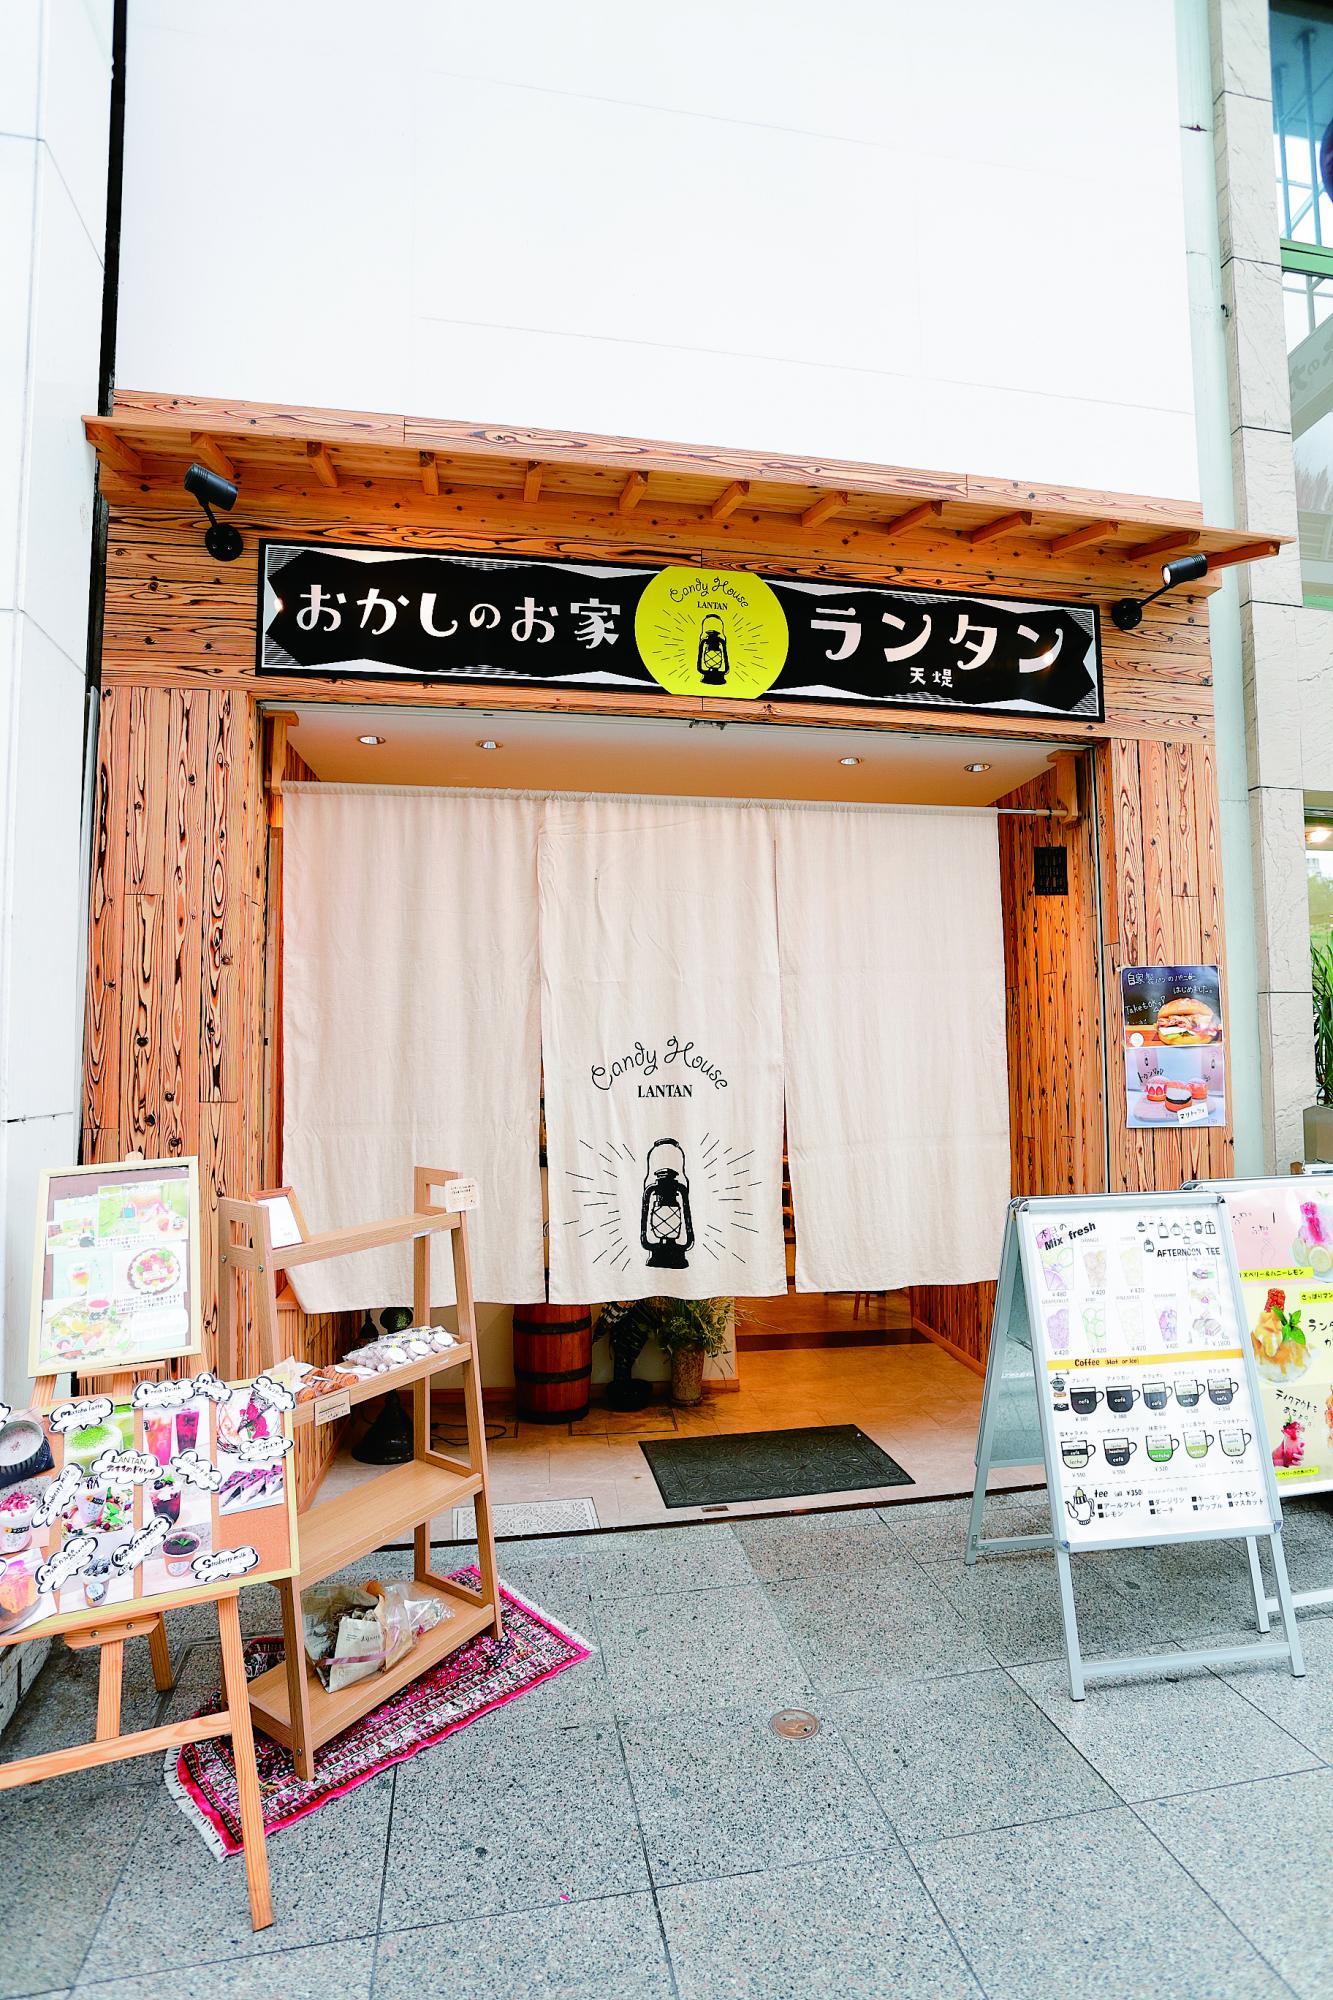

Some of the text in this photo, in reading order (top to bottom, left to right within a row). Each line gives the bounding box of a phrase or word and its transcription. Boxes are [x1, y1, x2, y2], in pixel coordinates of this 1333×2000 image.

[670, 576, 749, 608] Candy House
[697, 601, 728, 610] LANTAN
[296, 584, 621, 649] おかしのお家
[810, 607, 1063, 674] ランタン
[592, 1036, 728, 1090] Candy House
[638, 1084, 693, 1098] LANTAN
[1044, 1221, 1097, 1251] Mix fresh
[1205, 1247, 1222, 1256] TEE
[1074, 1358, 1100, 1367] Coffee
[110, 1455, 148, 1468] LANTAN
[1094, 1489, 1109, 1498] tee
[1103, 1501, 1142, 1509] アールグレイ
